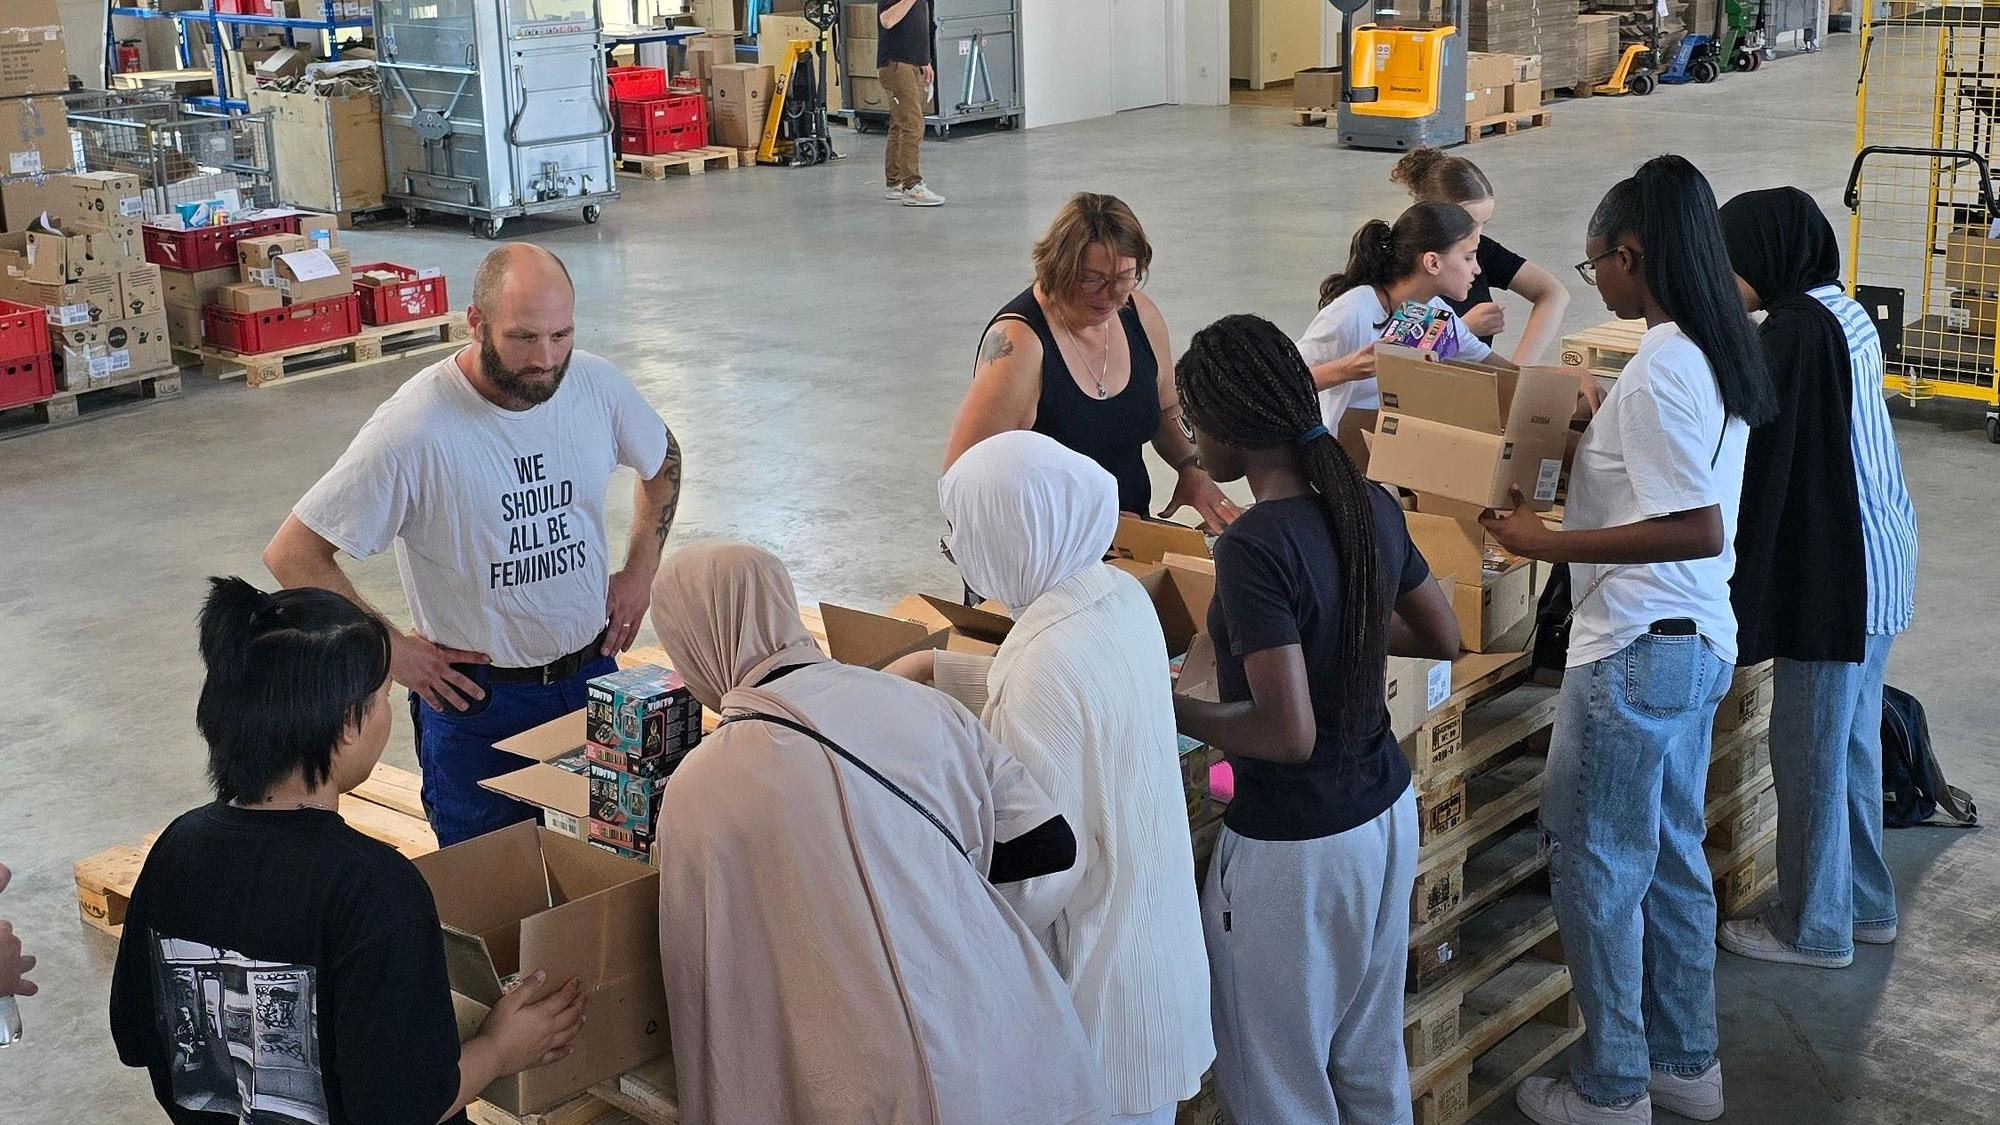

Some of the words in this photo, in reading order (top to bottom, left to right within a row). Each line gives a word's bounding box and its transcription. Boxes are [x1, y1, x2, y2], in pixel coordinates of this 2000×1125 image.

[513, 453, 546, 484] WE
[501, 480, 573, 522] SHOULD
[509, 522, 544, 554] ALL
[547, 512, 571, 545] BE
[490, 540, 586, 589] FEMINISTS
